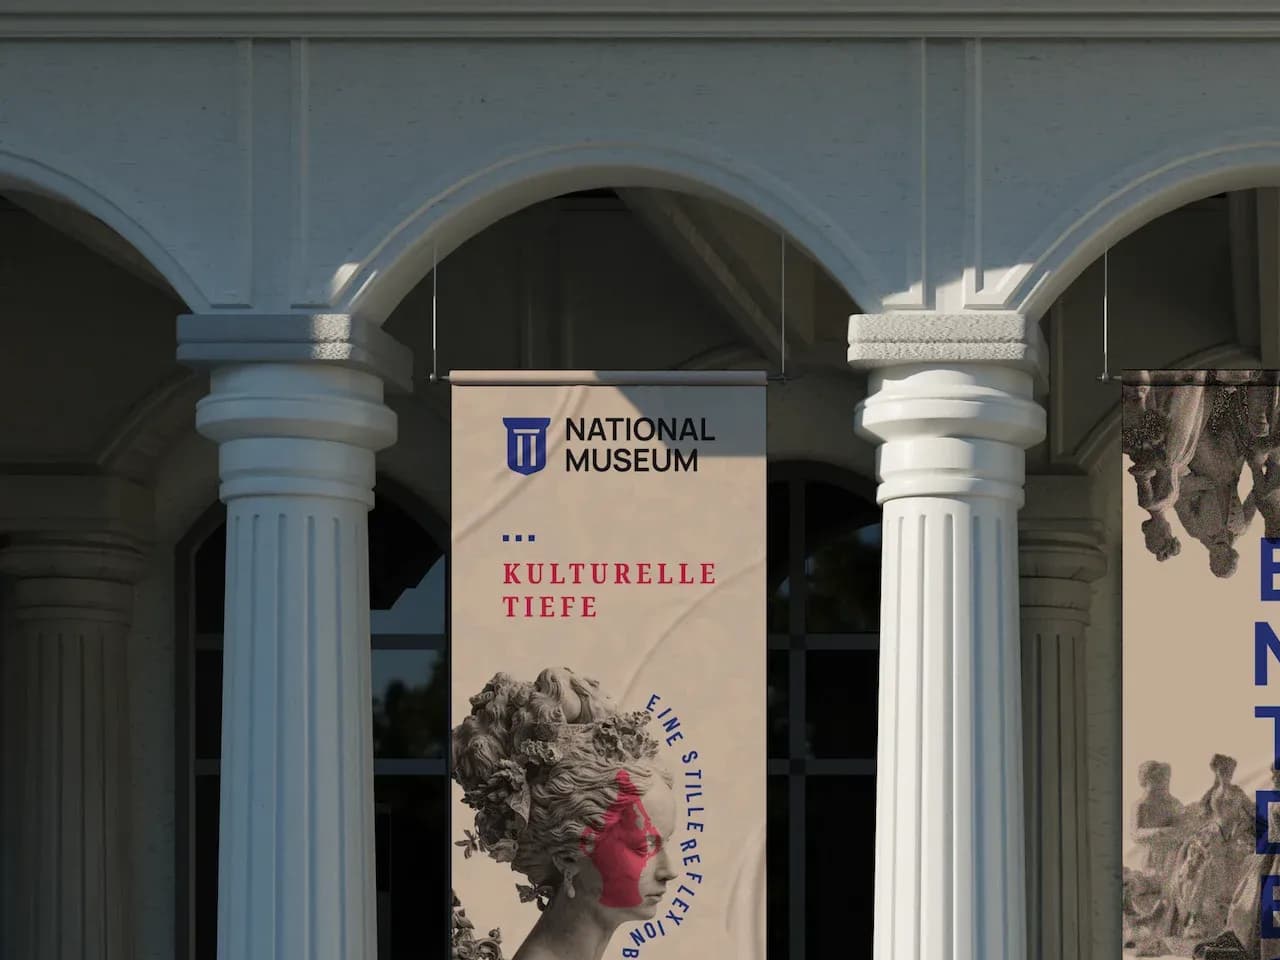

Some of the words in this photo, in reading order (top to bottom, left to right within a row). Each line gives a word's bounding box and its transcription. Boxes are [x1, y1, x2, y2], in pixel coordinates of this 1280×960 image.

[565, 416, 716, 442] NATIONAL
[565, 447, 699, 473] MUSEUM
[502, 562, 717, 585] KULTURELLE
[502, 595, 598, 618] TIEFE
[645, 693, 684, 747] EINE
[681, 750, 705, 833] STILLE
[629, 837, 704, 947] REFLEXION
